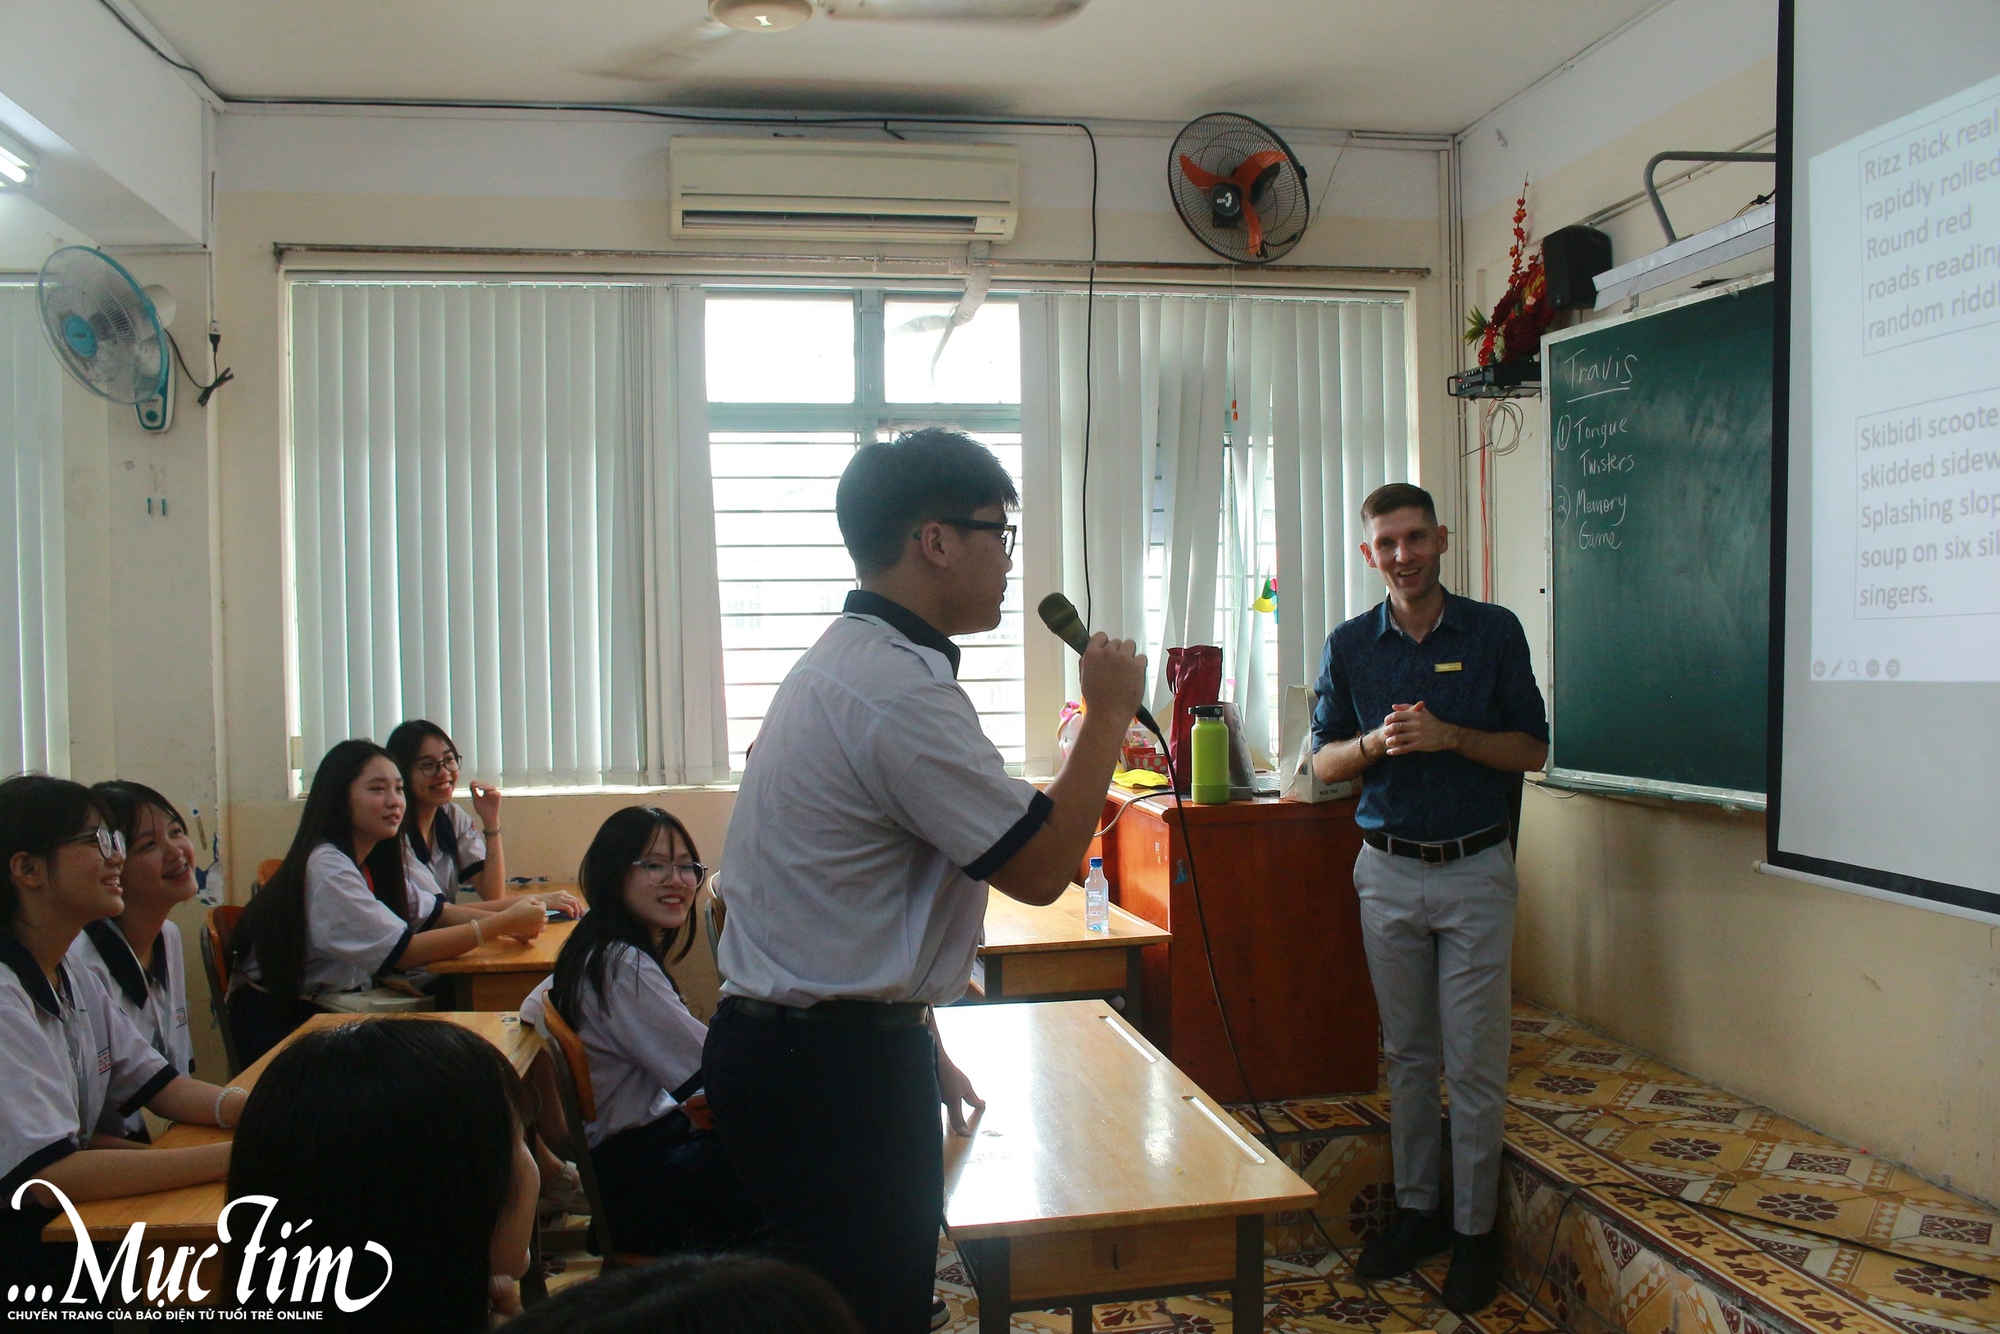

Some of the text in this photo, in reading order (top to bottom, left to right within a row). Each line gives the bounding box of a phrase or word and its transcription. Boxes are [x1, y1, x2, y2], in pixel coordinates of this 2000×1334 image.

[1864, 158, 1901, 184] Rizz
[1908, 129, 1951, 168] Rick
[1865, 148, 2000, 223] rapidly rolled
[1867, 203, 1973, 262] Round red
[1867, 242, 2000, 302] roads readin
[1868, 300, 1945, 340] random
[1564, 348, 1638, 390] Travis
[1574, 416, 1628, 448] Tongue
[1860, 406, 2000, 451] Skibidi scoote
[1580, 449, 1635, 477] Twisters
[1861, 453, 1935, 490] skidded
[1575, 488, 1627, 526] Memory
[1861, 488, 2000, 533] Splashing slop
[1579, 520, 1622, 550] Game
[1861, 529, 2000, 571] soup on six sil
[1860, 583, 1934, 610] singers.
